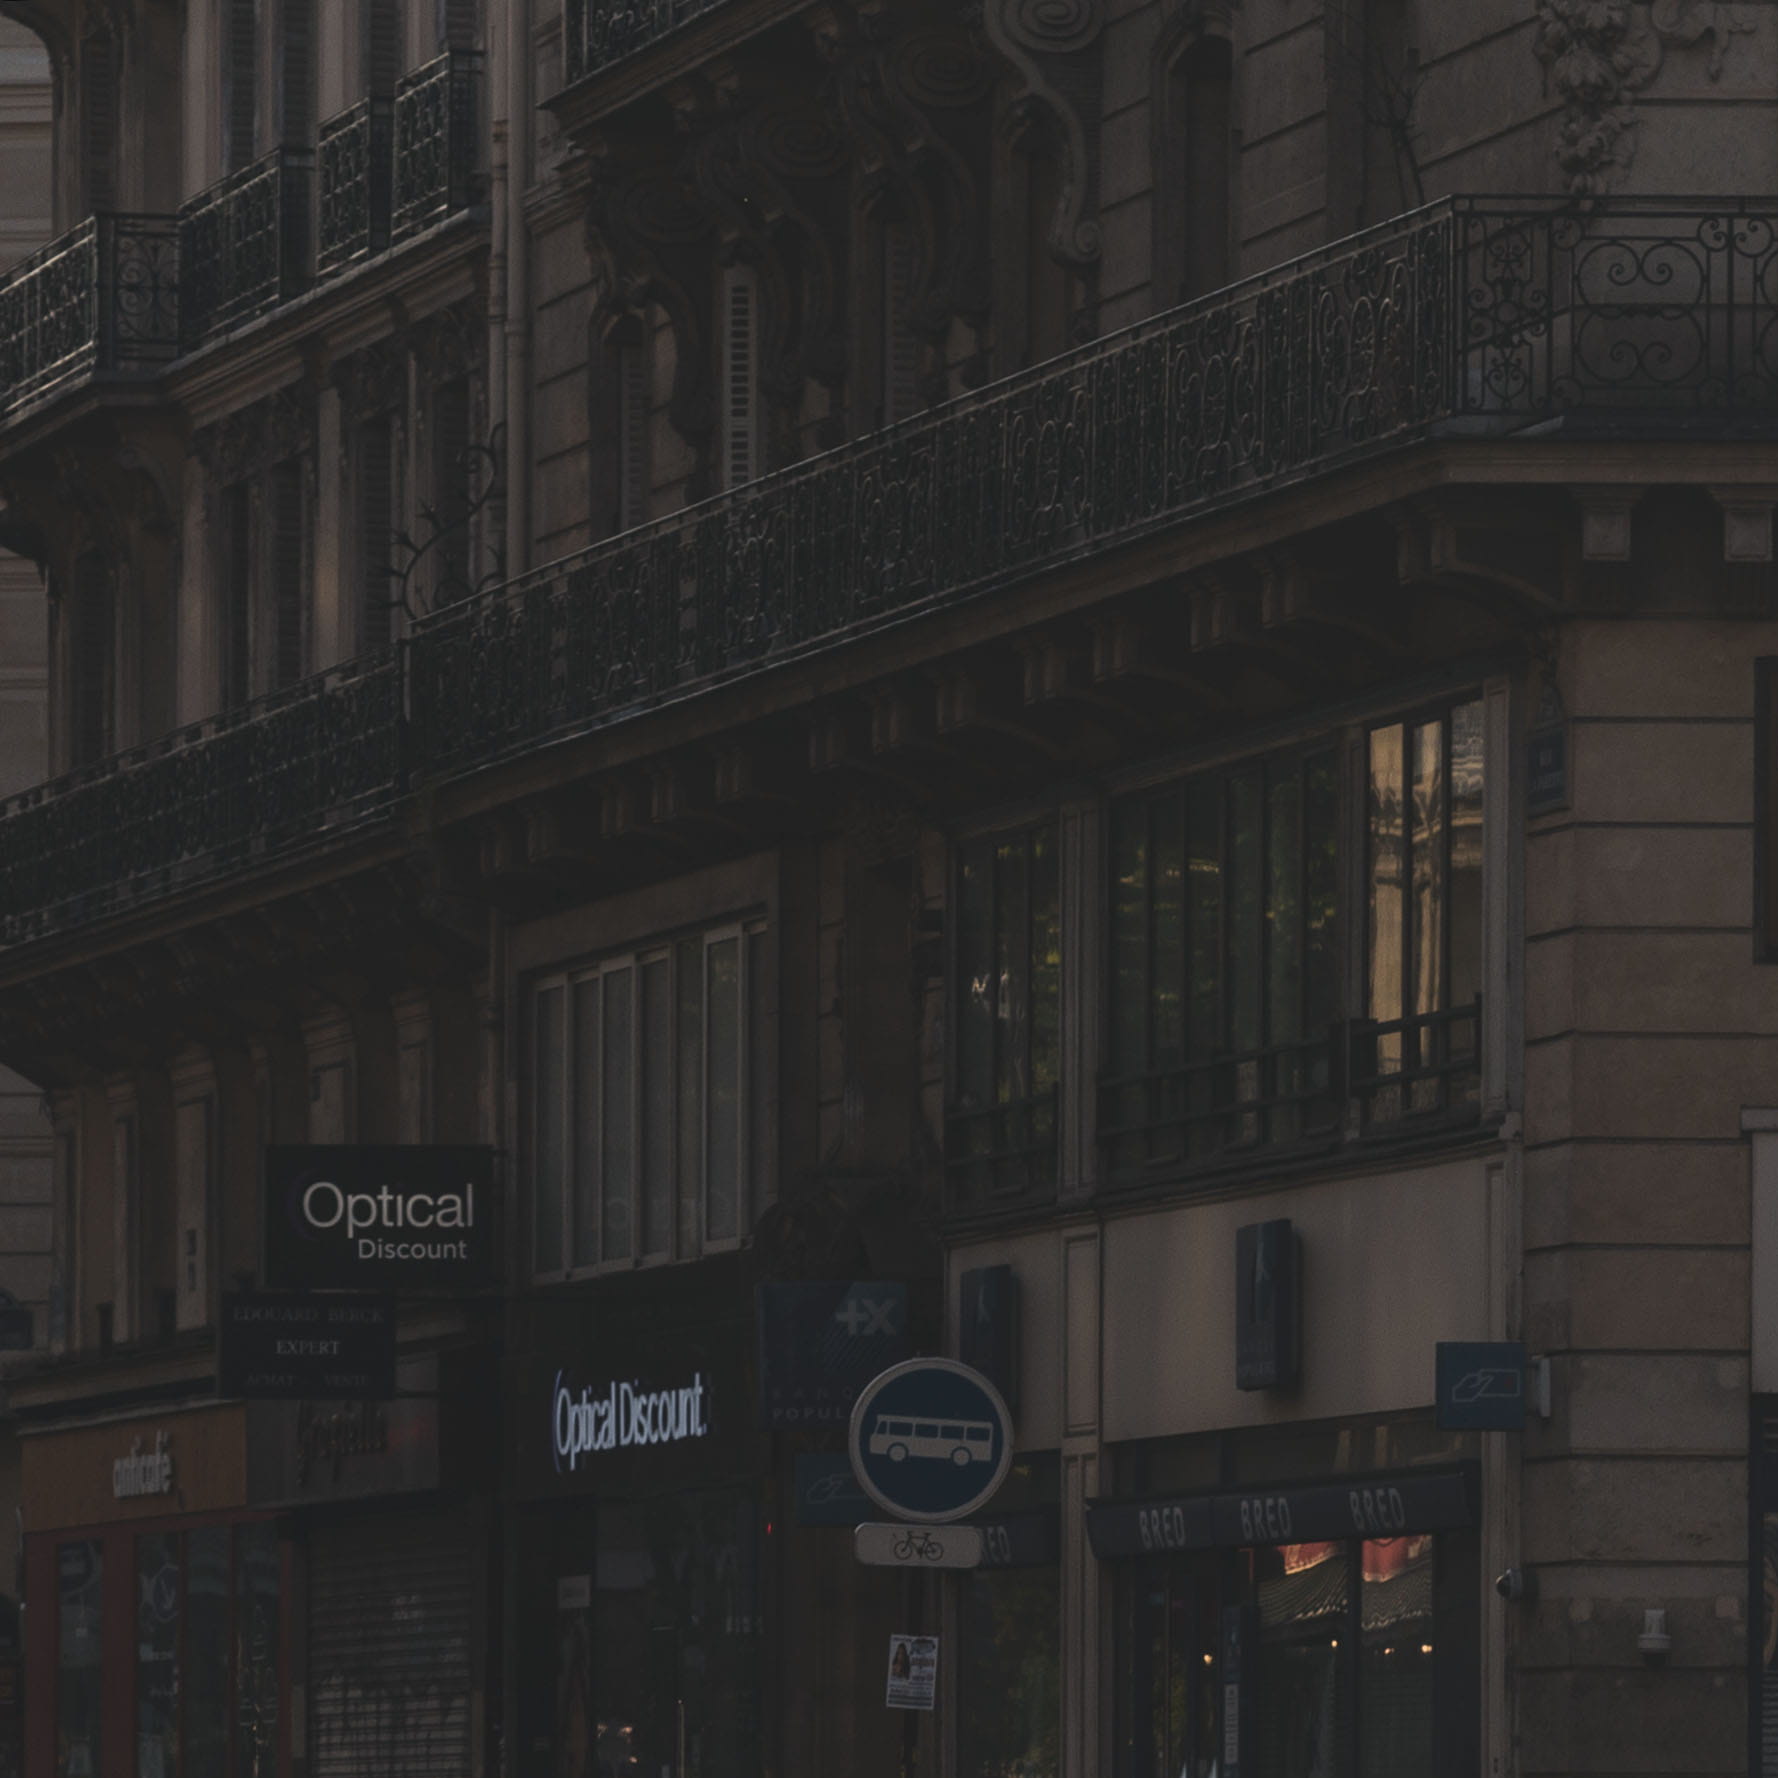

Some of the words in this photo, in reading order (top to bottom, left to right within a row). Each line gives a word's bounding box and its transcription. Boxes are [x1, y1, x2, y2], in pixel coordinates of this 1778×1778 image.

[303, 1181, 474, 1239] Optical
[358, 1238, 468, 1260] Discount
[275, 1339, 342, 1356] EXPERT
[556, 1380, 616, 1471] Optical
[619, 1373, 707, 1447] Discount
[1138, 1506, 1186, 1551] BRED
[1239, 1497, 1294, 1541] BRED
[1348, 1487, 1407, 1532] BRED
